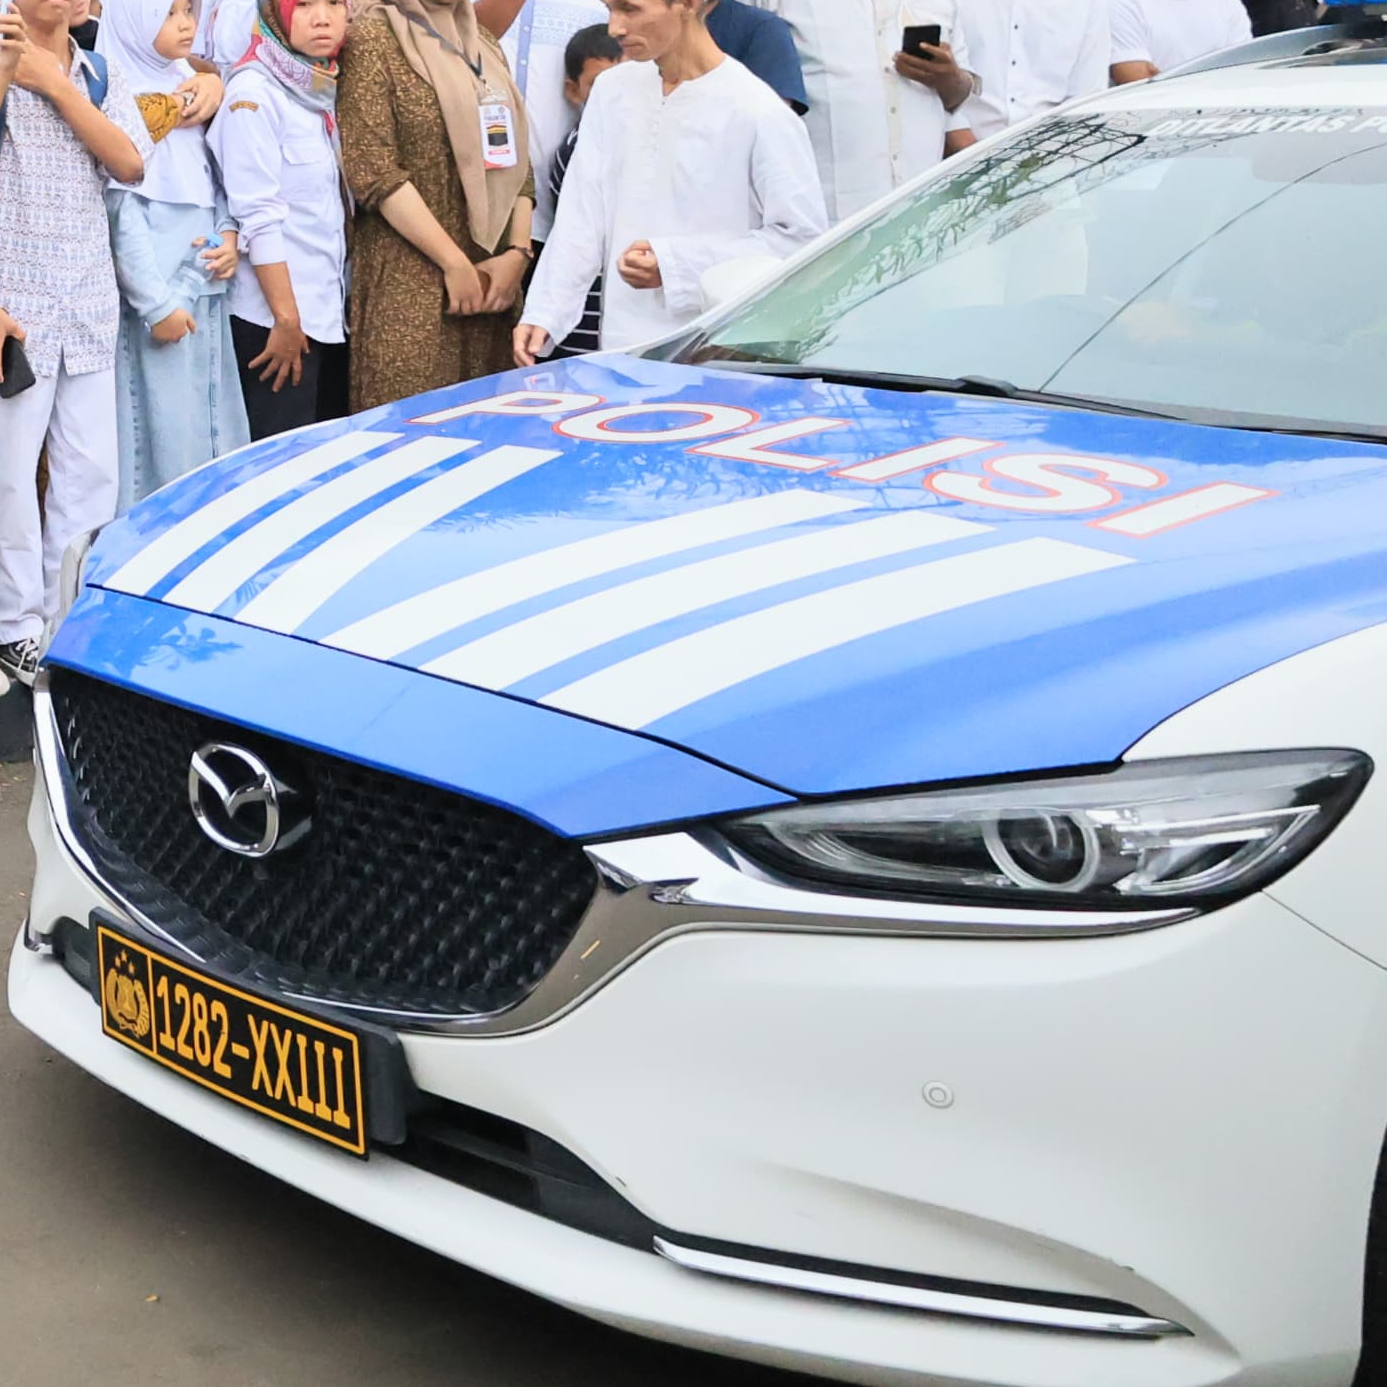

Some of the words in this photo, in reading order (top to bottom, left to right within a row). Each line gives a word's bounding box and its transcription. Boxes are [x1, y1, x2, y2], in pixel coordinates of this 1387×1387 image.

[1146, 115, 1355, 135] DITLANTAS
[406, 390, 1278, 539] POLISI
[156, 975, 351, 1129] 1282-XXIII
